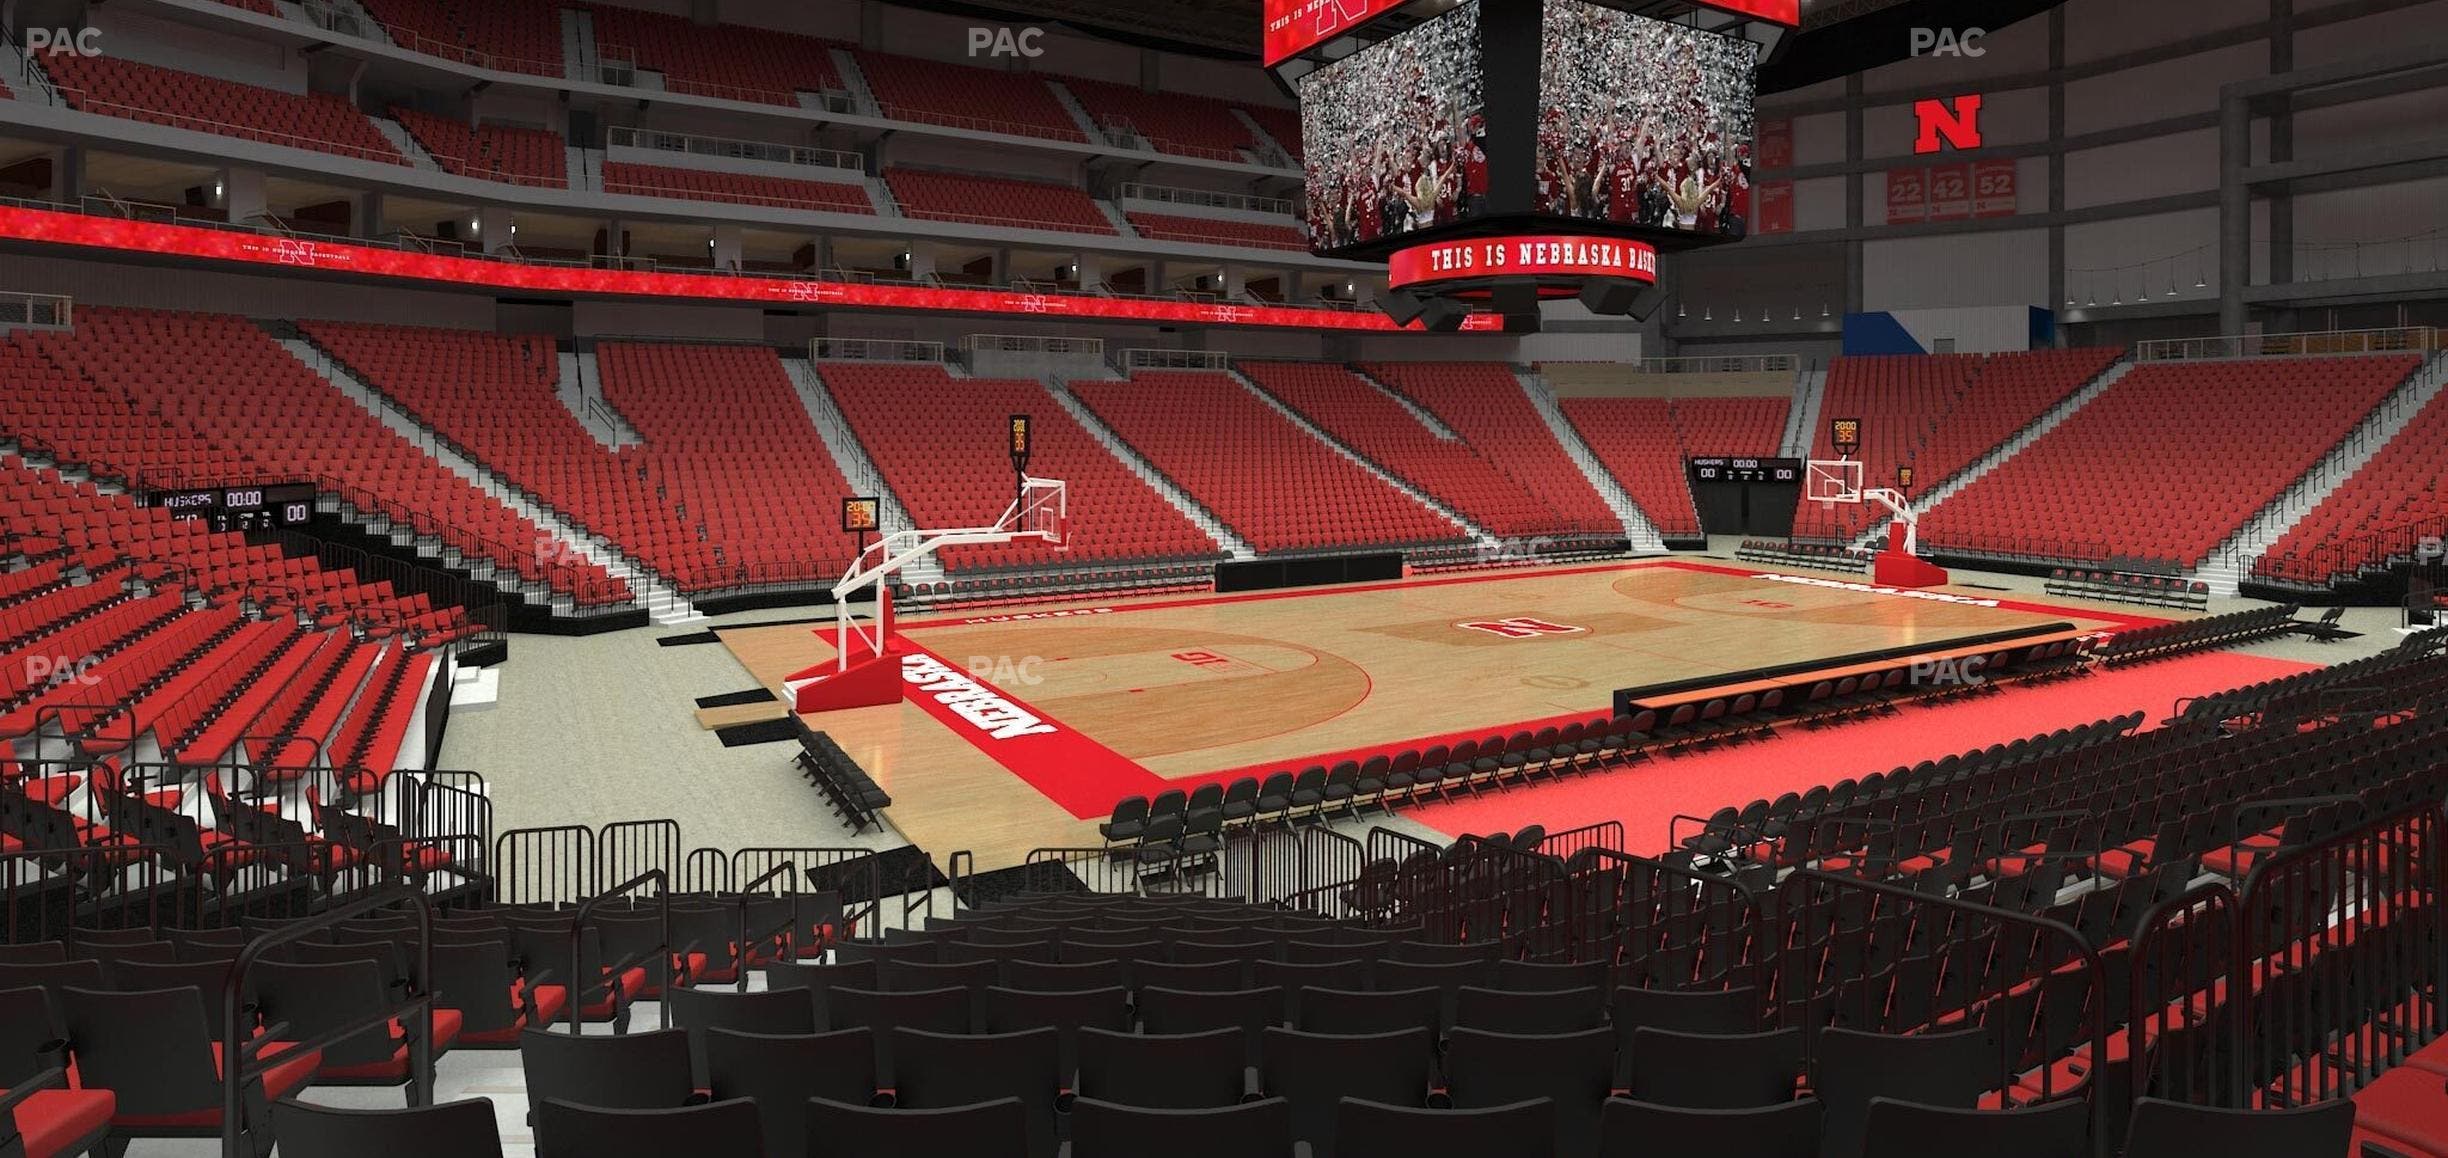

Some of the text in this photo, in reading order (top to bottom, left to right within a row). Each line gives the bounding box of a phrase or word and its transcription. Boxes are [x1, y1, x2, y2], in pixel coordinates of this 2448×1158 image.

[1913, 93, 1983, 155] N
[1891, 183, 1923, 202] 22
[1932, 179, 1965, 199] 42
[1979, 174, 2012, 194] 52
[279, 239, 315, 266] N
[1431, 245, 1474, 271] THIS
[1485, 244, 1506, 267] IS
[1518, 242, 1622, 270] NEBRASKA
[1700, 468, 1716, 479] 00
[1776, 469, 1793, 479] 00
[226, 490, 262, 508] 00:00
[286, 504, 307, 523] 00
